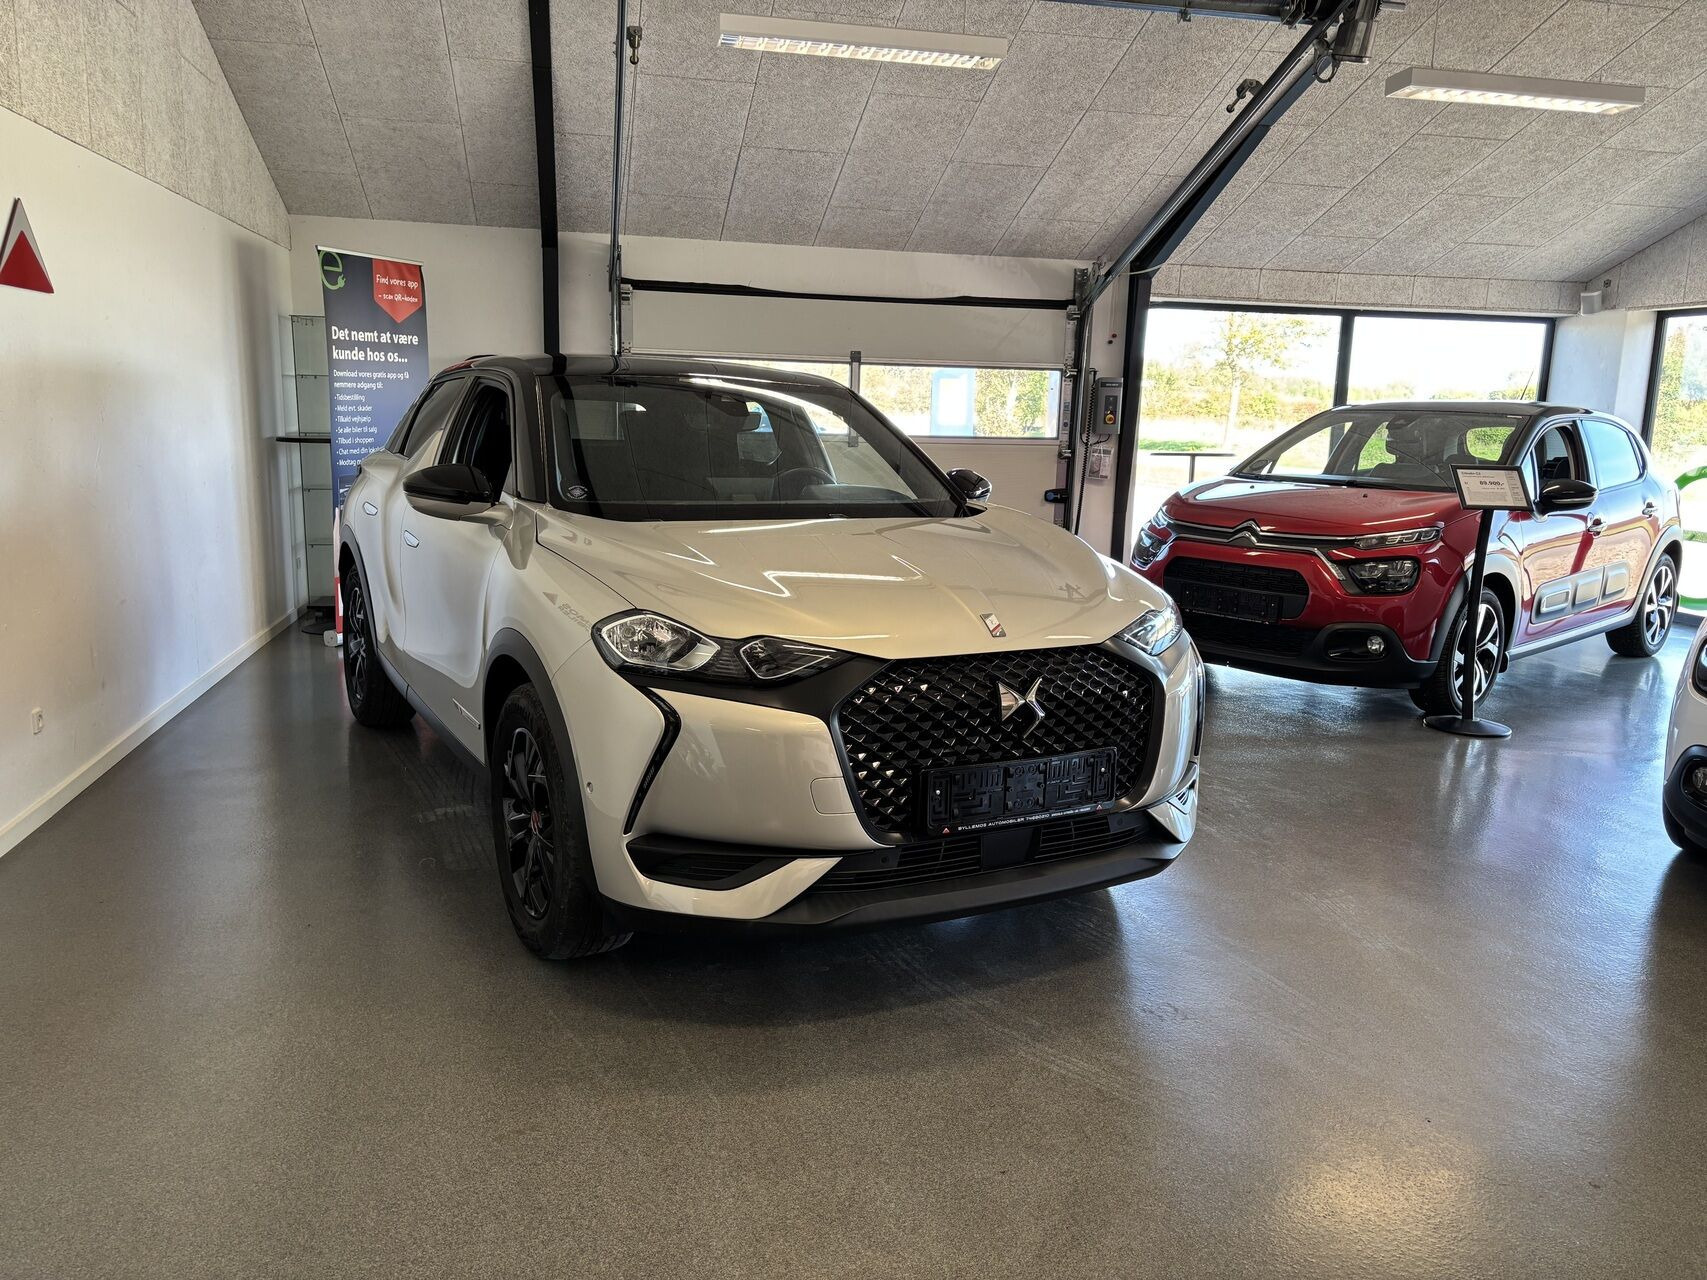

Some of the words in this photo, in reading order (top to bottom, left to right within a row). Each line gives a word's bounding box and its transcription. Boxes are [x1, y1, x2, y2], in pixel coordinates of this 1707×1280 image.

[376, 274, 388, 285] Find
[390, 278, 406, 287] vores
[407, 281, 418, 290] app
[394, 294, 418, 303] QR-koden
[332, 326, 349, 340] Det
[351, 330, 378, 342] nemt
[380, 332, 391, 343] at
[392, 334, 419, 345] være
[332, 345, 365, 360] kunde
[367, 347, 385, 362] hos
[387, 352, 408, 363] os...
[334, 369, 358, 378] Download
[373, 372, 386, 380] gratis
[357, 382, 376, 390] adgang
